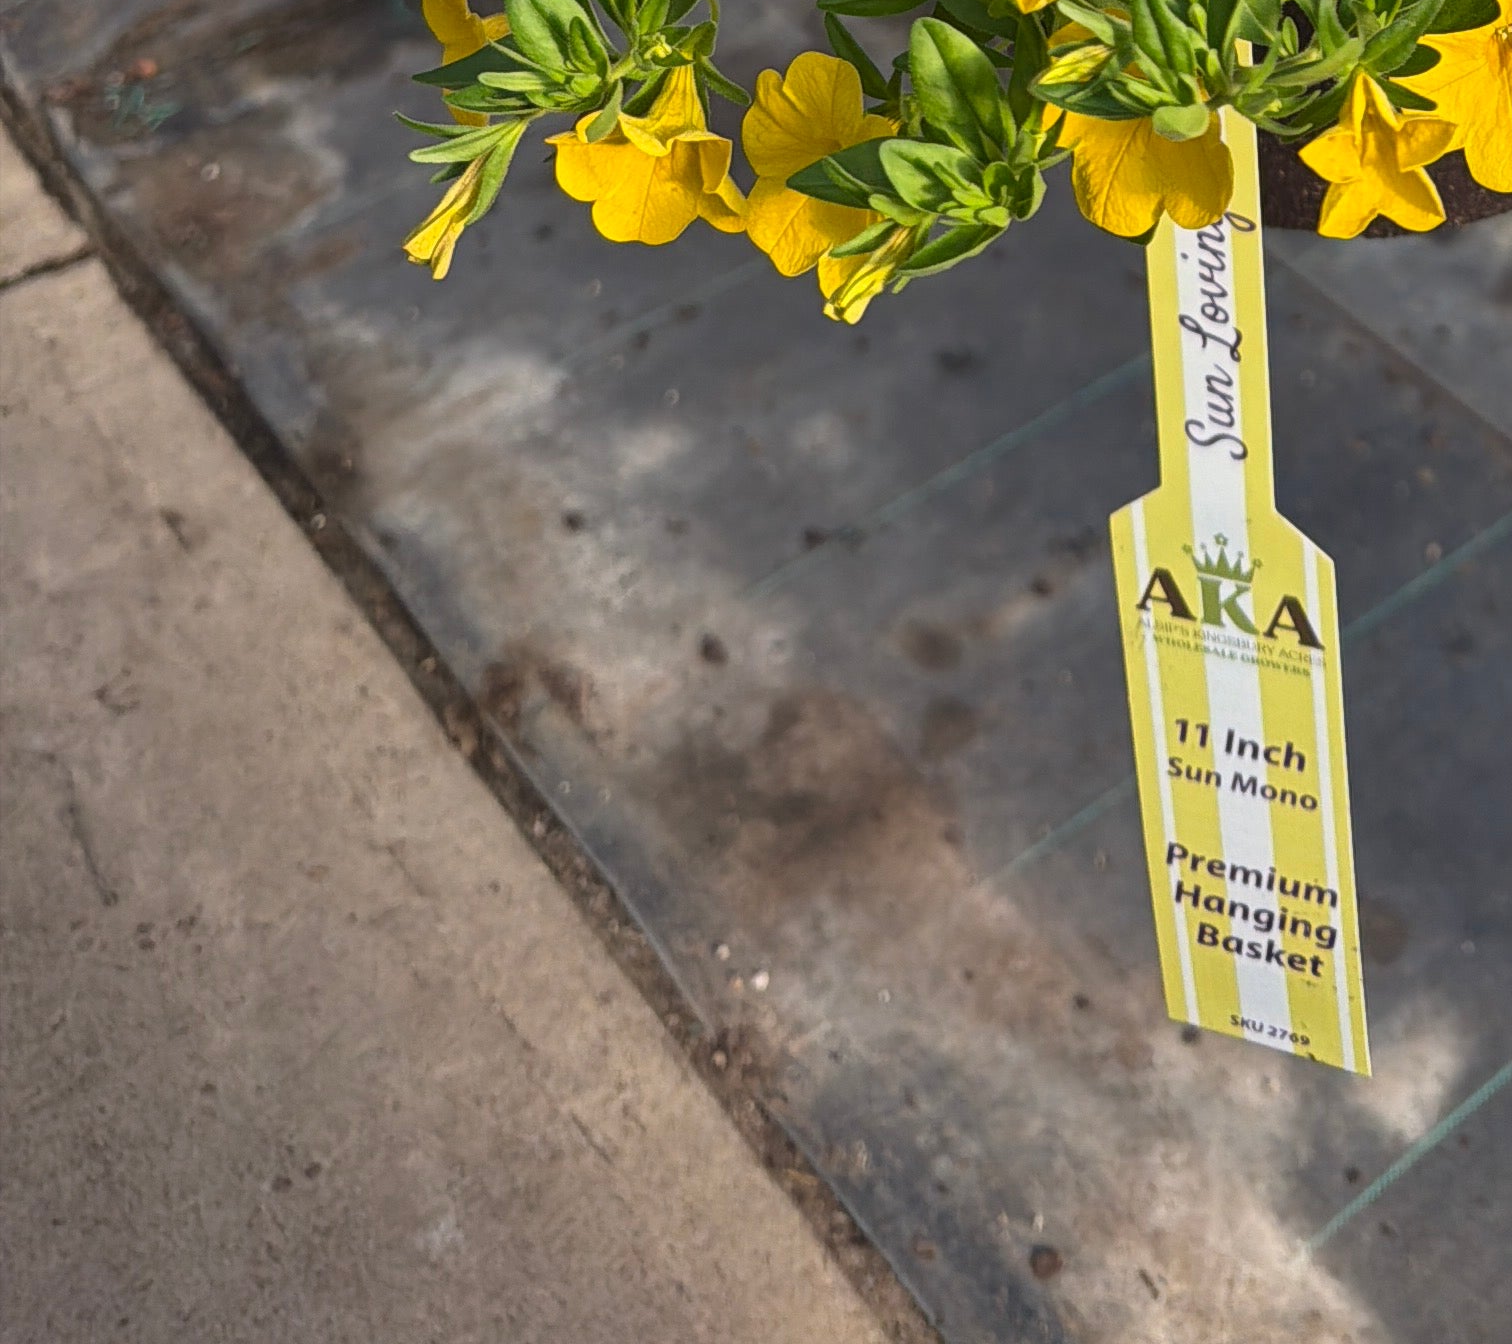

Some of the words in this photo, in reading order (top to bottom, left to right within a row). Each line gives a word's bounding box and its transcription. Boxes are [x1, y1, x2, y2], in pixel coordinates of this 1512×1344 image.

[1178, 210, 1257, 363] Loving
[1184, 363, 1248, 461] Sun
[1135, 567, 1325, 651] AKA
[1175, 717, 1210, 749] 11
[1225, 728, 1306, 773] Inch
[1167, 756, 1222, 788] Sun
[1231, 772, 1318, 812] Mono
[1165, 841, 1338, 909] Premium
[1175, 880, 1337, 950] Hanging
[1197, 921, 1325, 978] Basket
[1230, 1013, 1263, 1033] SKU
[1267, 1024, 1310, 1047] 2769
